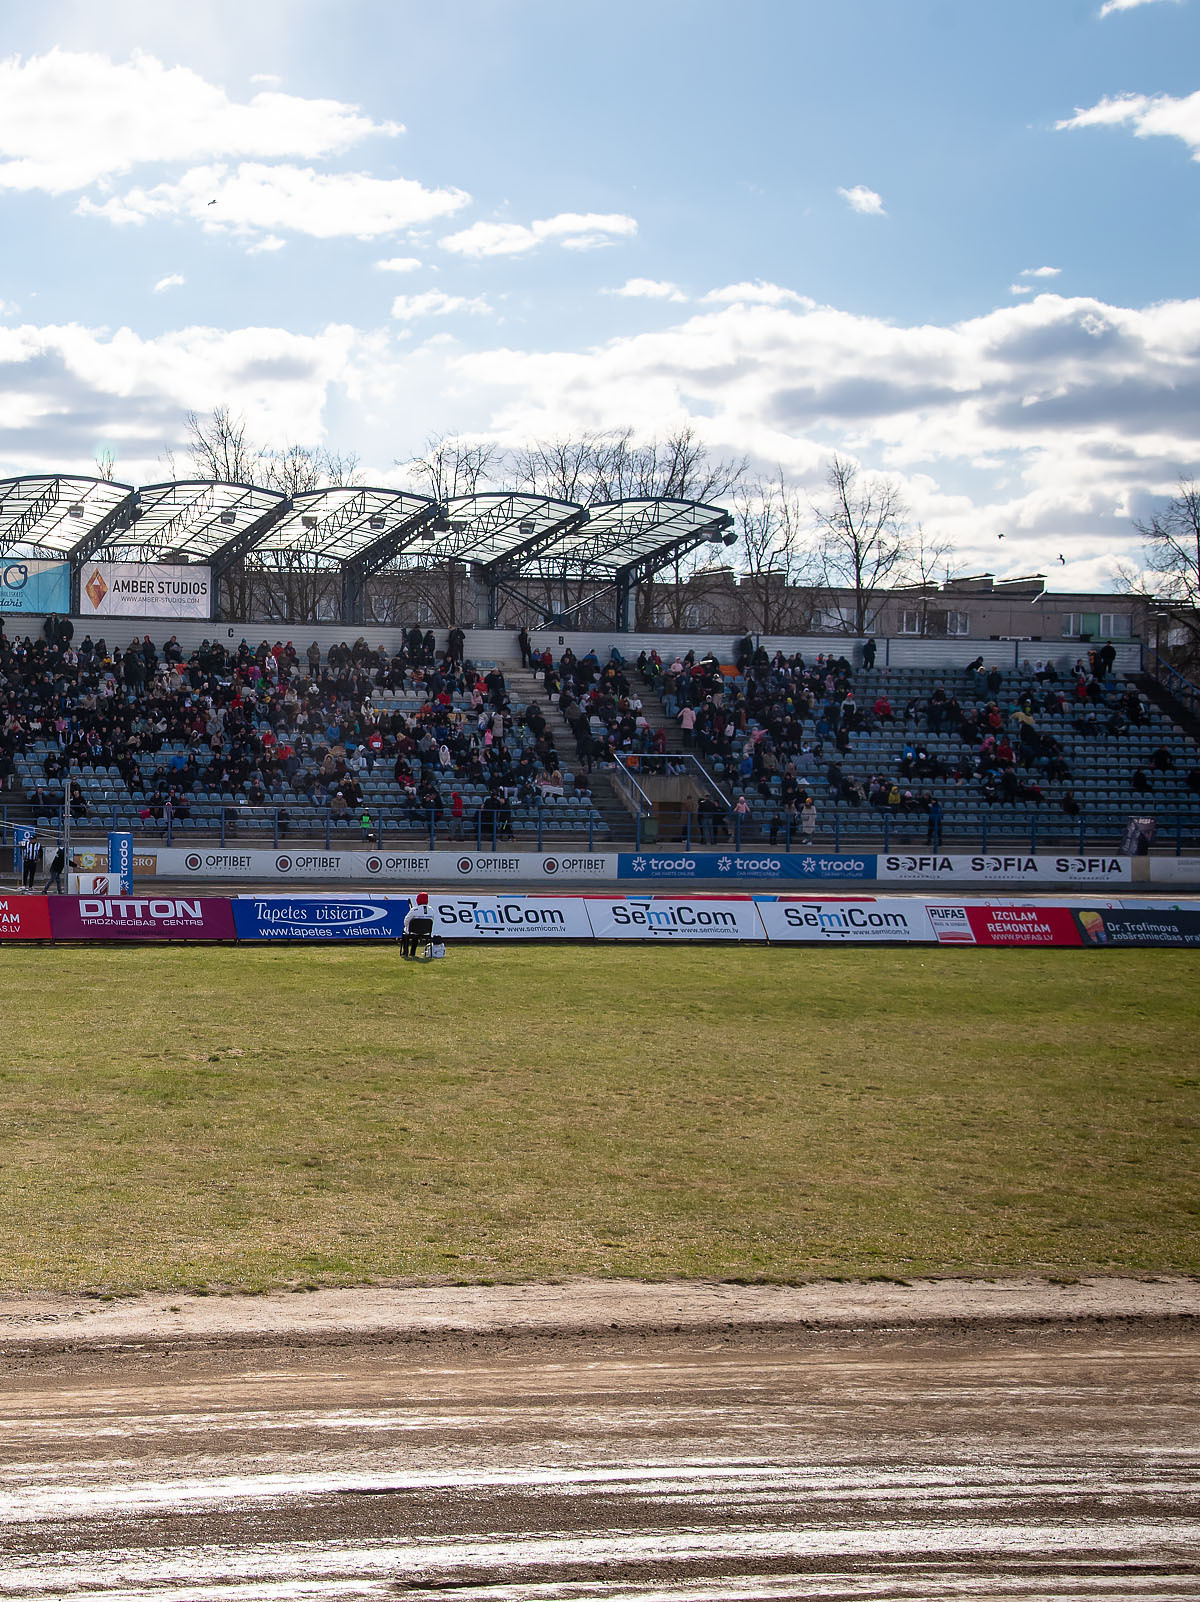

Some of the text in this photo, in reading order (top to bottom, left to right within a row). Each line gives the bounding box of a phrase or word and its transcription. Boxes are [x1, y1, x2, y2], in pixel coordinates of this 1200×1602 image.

[113, 580, 207, 594] AMBER STUDIOS
[228, 628, 234, 637] C
[558, 636, 564, 645] B
[119, 839, 128, 878] trodo
[205, 855, 252, 867] OPTIBET
[295, 857, 341, 868] OPTIBET
[385, 858, 429, 869] OPTIBET
[476, 859, 520, 869] OPTIBET
[648, 858, 696, 870] trodo
[734, 858, 781, 870] trodo
[561, 859, 605, 870] OPTIBET
[818, 859, 865, 871] trodo
[78, 900, 203, 918] DITTON
[254, 902, 364, 923] Tapetes visiem
[439, 903, 565, 924] SemiCom
[929, 909, 965, 919] PUFAS
[612, 906, 737, 925] SemiCom
[784, 908, 908, 927] SemiCom
[992, 911, 1038, 921] IZCILAM
[80, 918, 156, 926] TIRDZNIECĪBAS
[987, 922, 1051, 933] REMONTAM
[1106, 922, 1179, 933] Dr. Trofimova
[506, 924, 566, 933] www.semicom.lv
[680, 926, 739, 934] www.semicom.lv
[852, 928, 910, 936] www.semicom.lv
[991, 933, 1053, 942] WWW.PUFAS.LV
